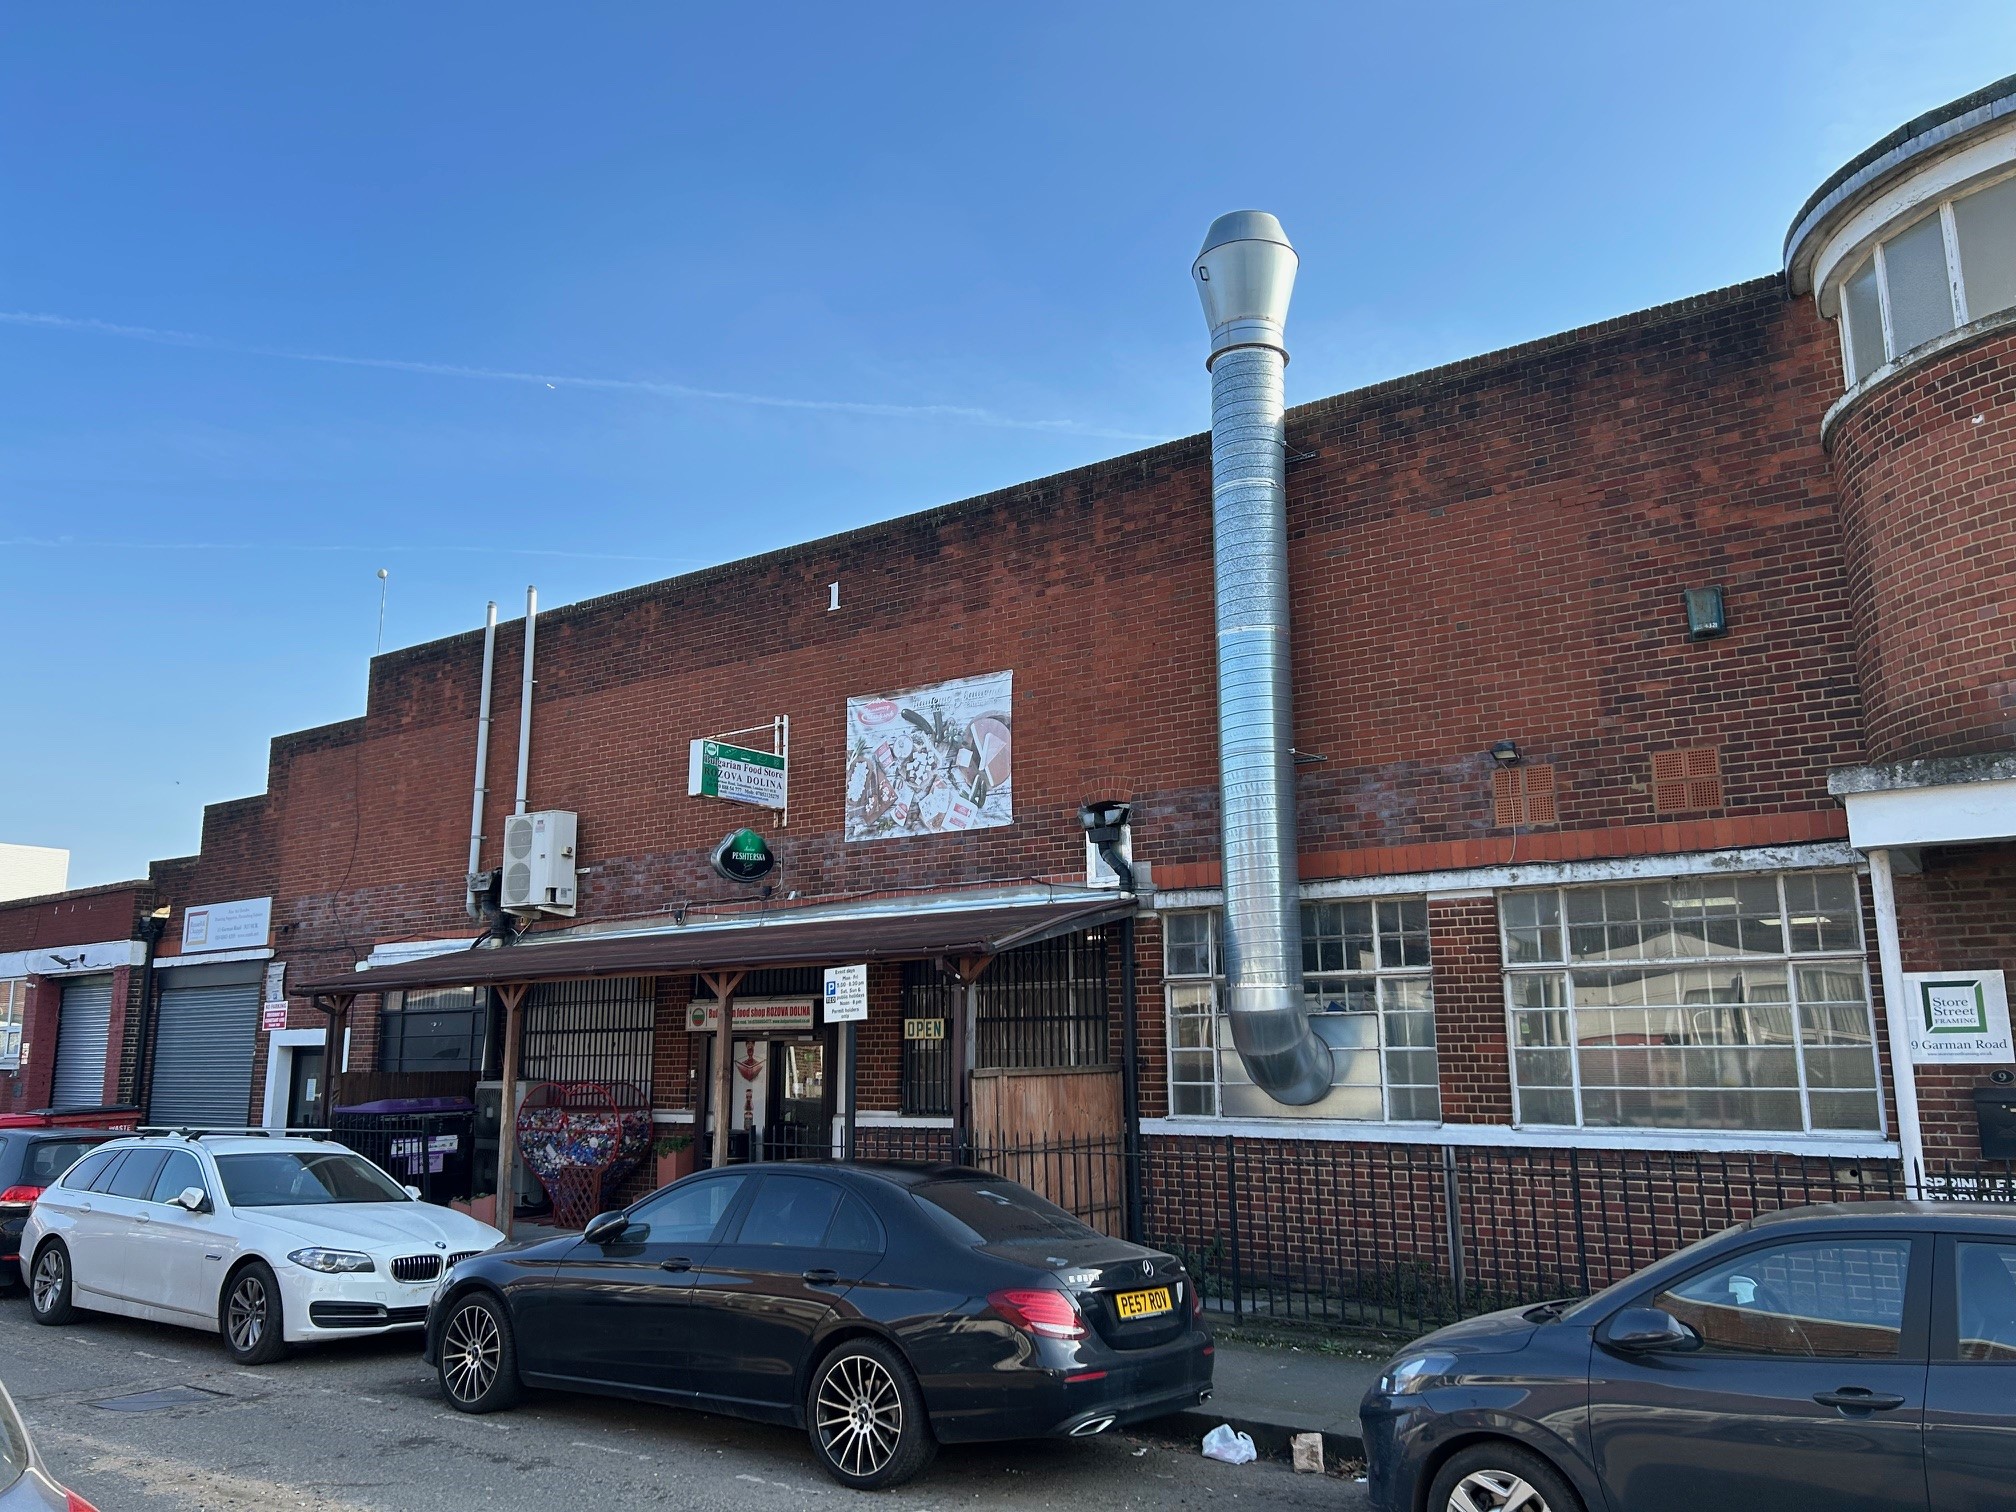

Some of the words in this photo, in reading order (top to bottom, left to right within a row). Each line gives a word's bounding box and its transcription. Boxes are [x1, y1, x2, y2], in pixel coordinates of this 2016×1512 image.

[828, 581, 842, 611] 1
[704, 754, 742, 770] Bulgarian
[743, 763, 762, 775] Food
[764, 767, 784, 779] Store
[704, 767, 743, 783] ROZOVA
[746, 775, 783, 790] DOLINA
[1932, 997, 1969, 1007] Store
[737, 1007, 751, 1018] food
[751, 1007, 766, 1019] shop
[766, 1006, 789, 1017] ROZOVA
[789, 1005, 811, 1017] DOLINA
[1933, 1006, 1975, 1016] Street
[907, 1021, 942, 1037] OPEN
[1910, 1041, 1919, 1050] 9
[1922, 1040, 1972, 1050] Garman
[1975, 1039, 2008, 1049] Road
[1998, 1072, 2007, 1081] 9
[1120, 1294, 1147, 1315] PE57
[1149, 1290, 1167, 1310] ROV
